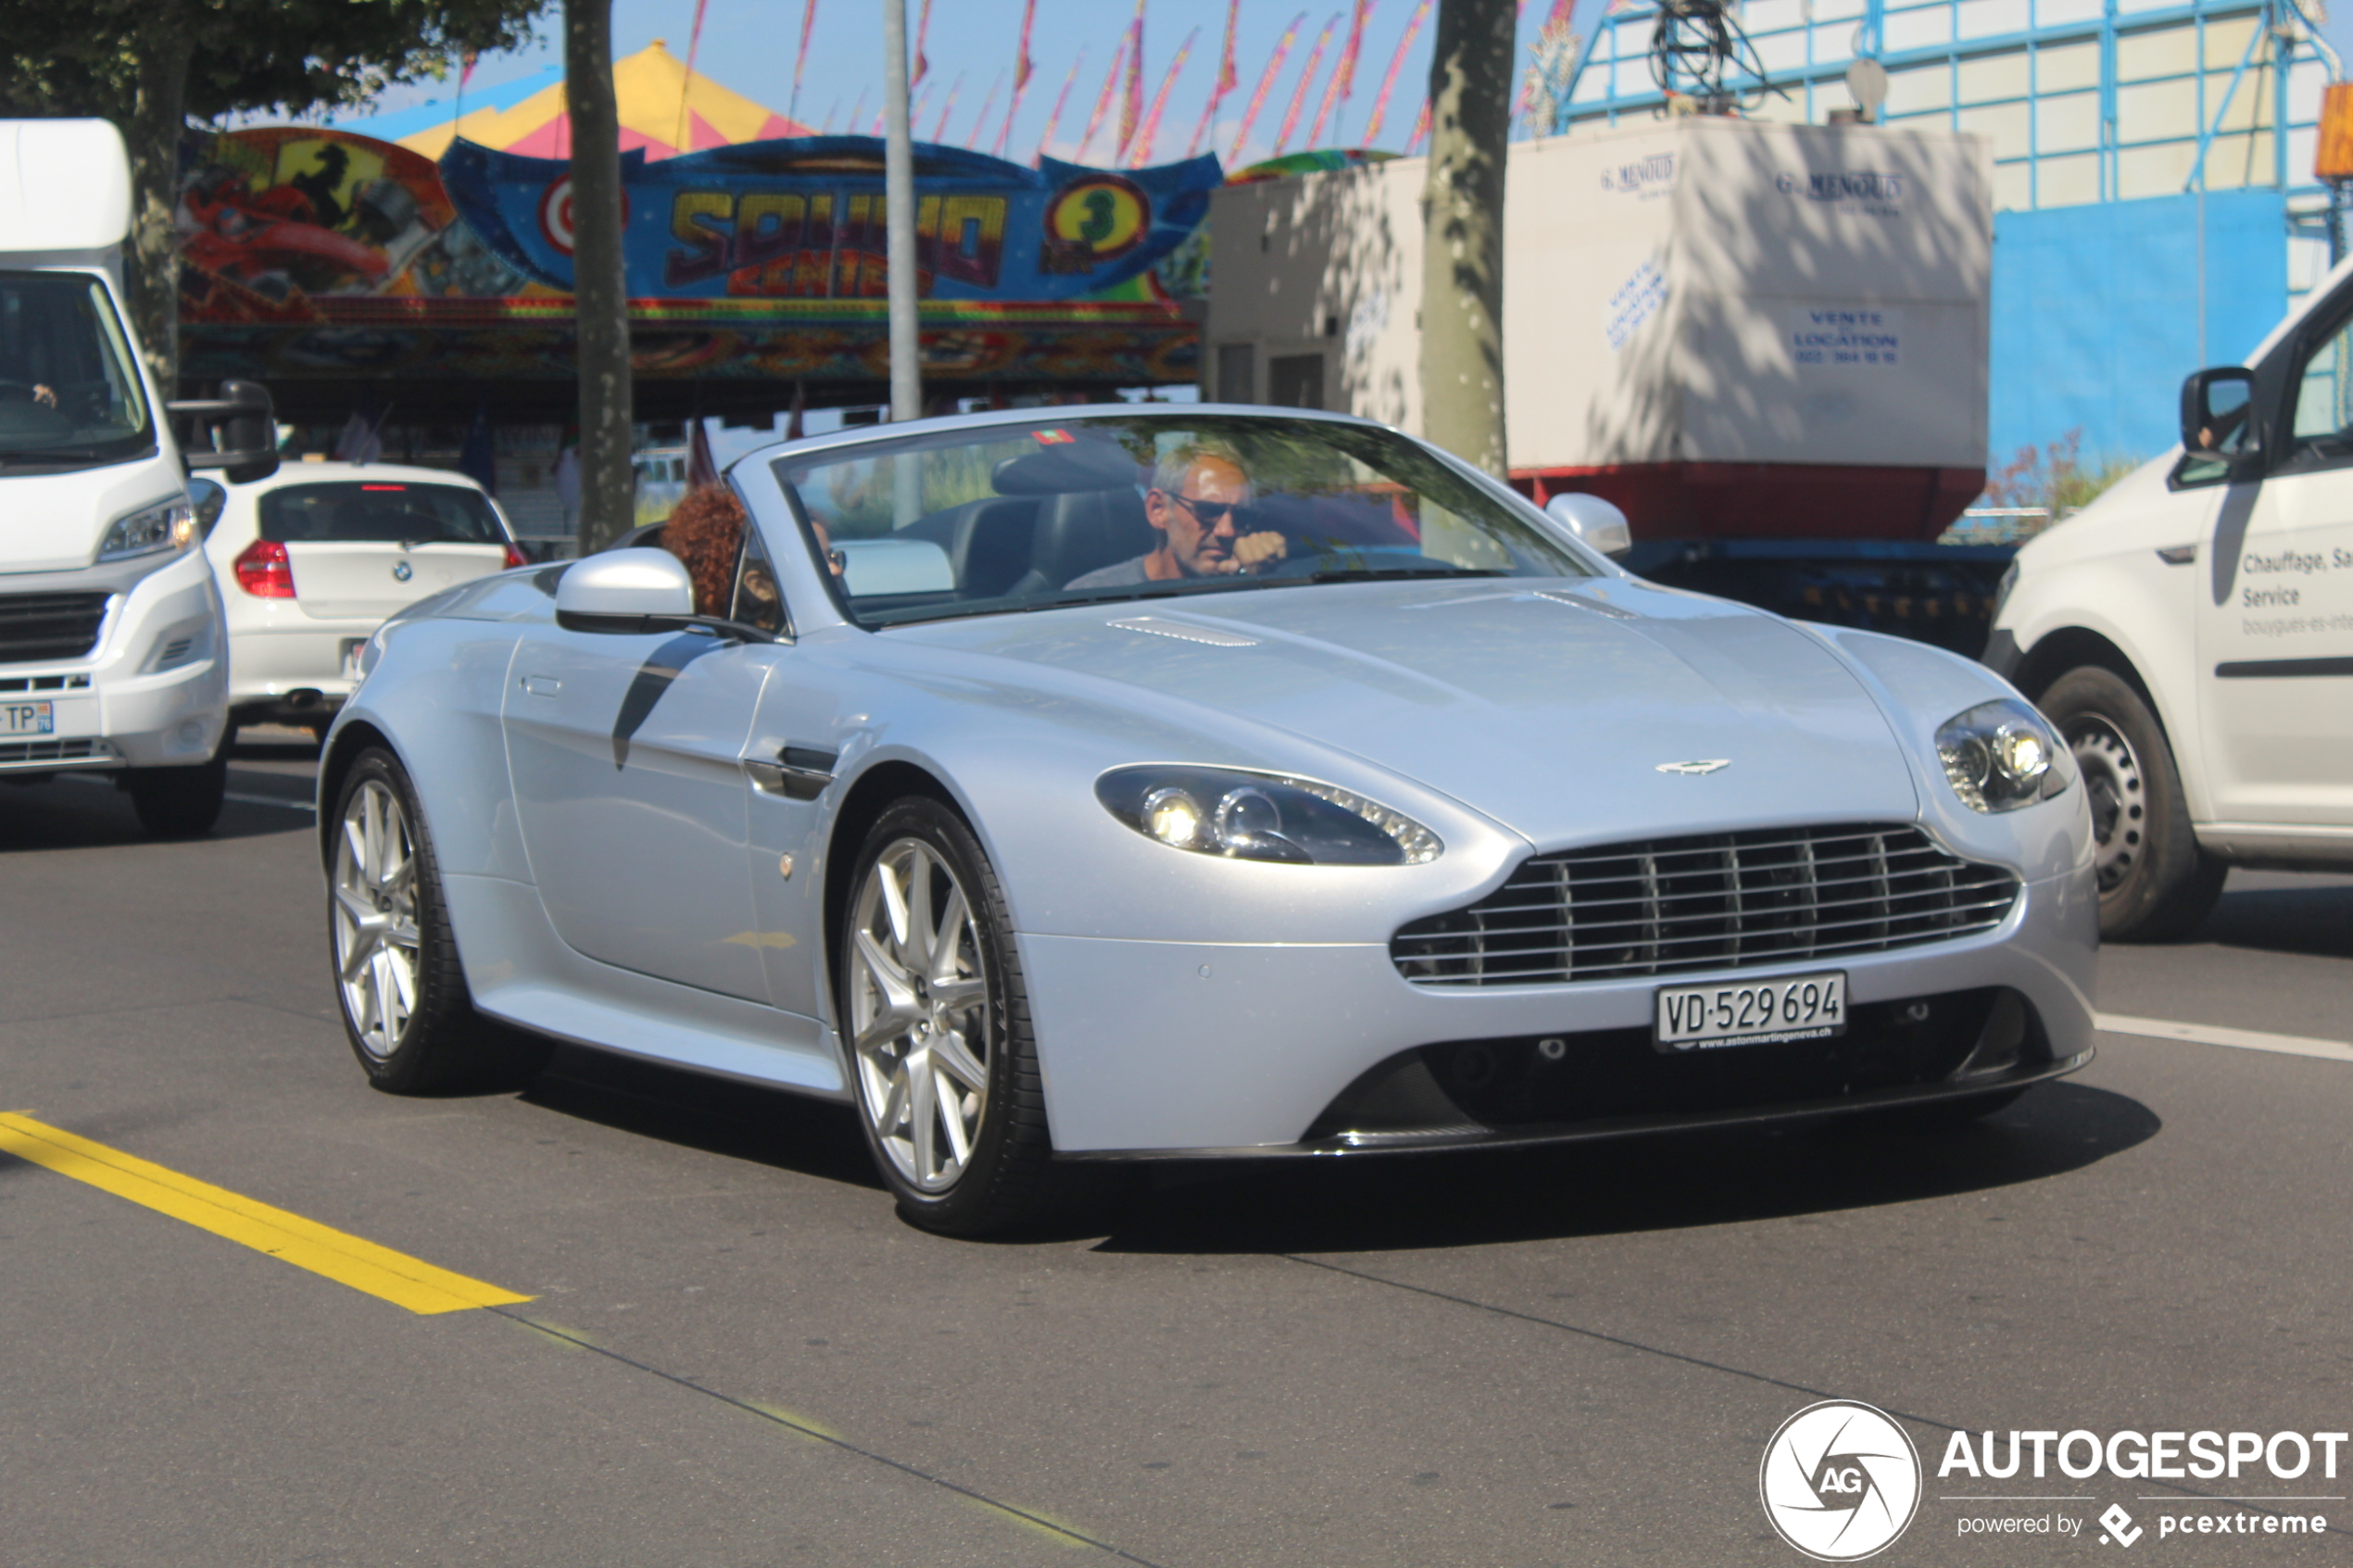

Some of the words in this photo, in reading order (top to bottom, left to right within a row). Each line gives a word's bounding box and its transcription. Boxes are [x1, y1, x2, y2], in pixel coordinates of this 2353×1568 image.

[1618, 156, 1675, 189] MENOUD
[1808, 172, 1903, 201] MENOUD
[1079, 189, 1115, 242] 3
[664, 191, 1008, 288] SOUND
[1809, 310, 1881, 326] VENTE
[1793, 332, 1898, 348] LOCATION
[2244, 551, 2328, 574] Chauffage,
[2243, 585, 2300, 608] Service
[1699, 1026, 1832, 1049] www.astonmartingeneva.ch
